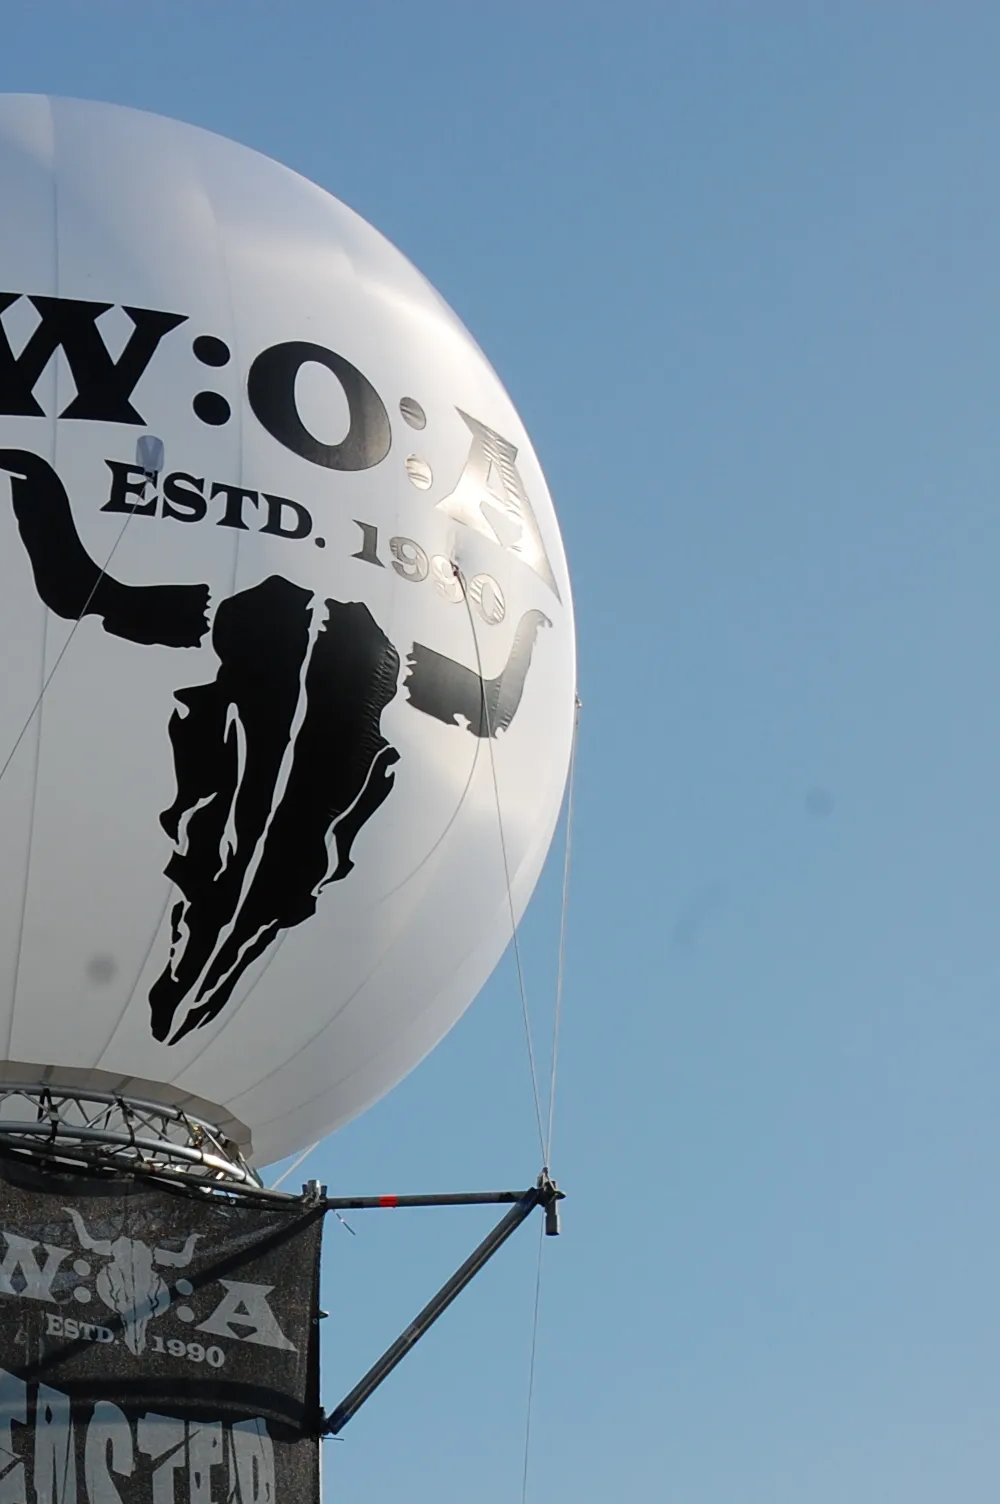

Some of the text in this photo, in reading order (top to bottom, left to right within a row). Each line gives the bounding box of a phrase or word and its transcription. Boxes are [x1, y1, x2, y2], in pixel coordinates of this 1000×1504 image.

[100, 459, 507, 626] ESTD. 1990
[46, 1313, 226, 1369] ESTD. 1990
